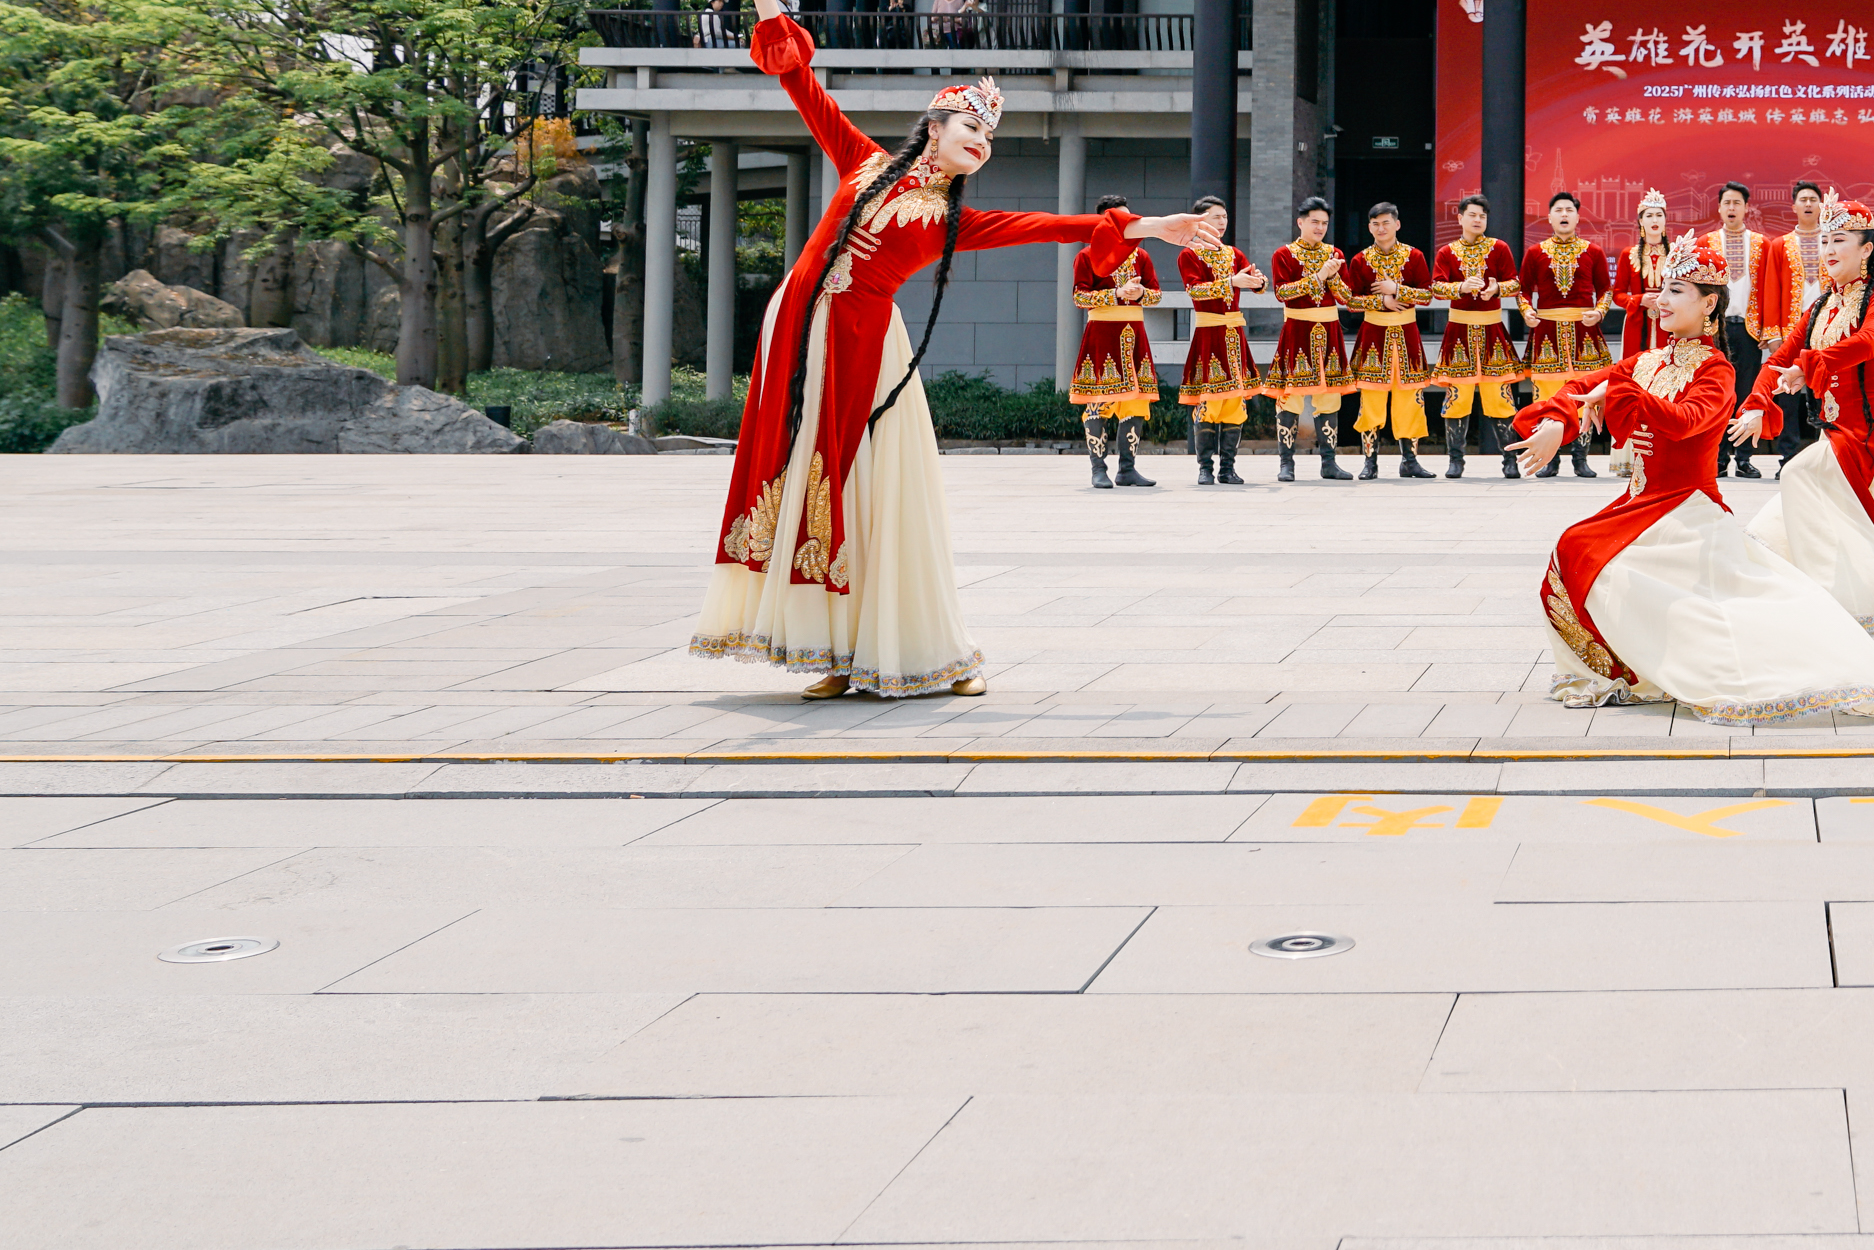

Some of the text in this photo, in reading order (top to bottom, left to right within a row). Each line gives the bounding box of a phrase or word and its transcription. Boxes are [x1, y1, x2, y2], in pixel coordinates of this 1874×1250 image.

[1582, 106, 1666, 126] 赏英雄花
[1673, 107, 1758, 126] 游英雄城
[1765, 107, 1849, 126] 传英雄志
